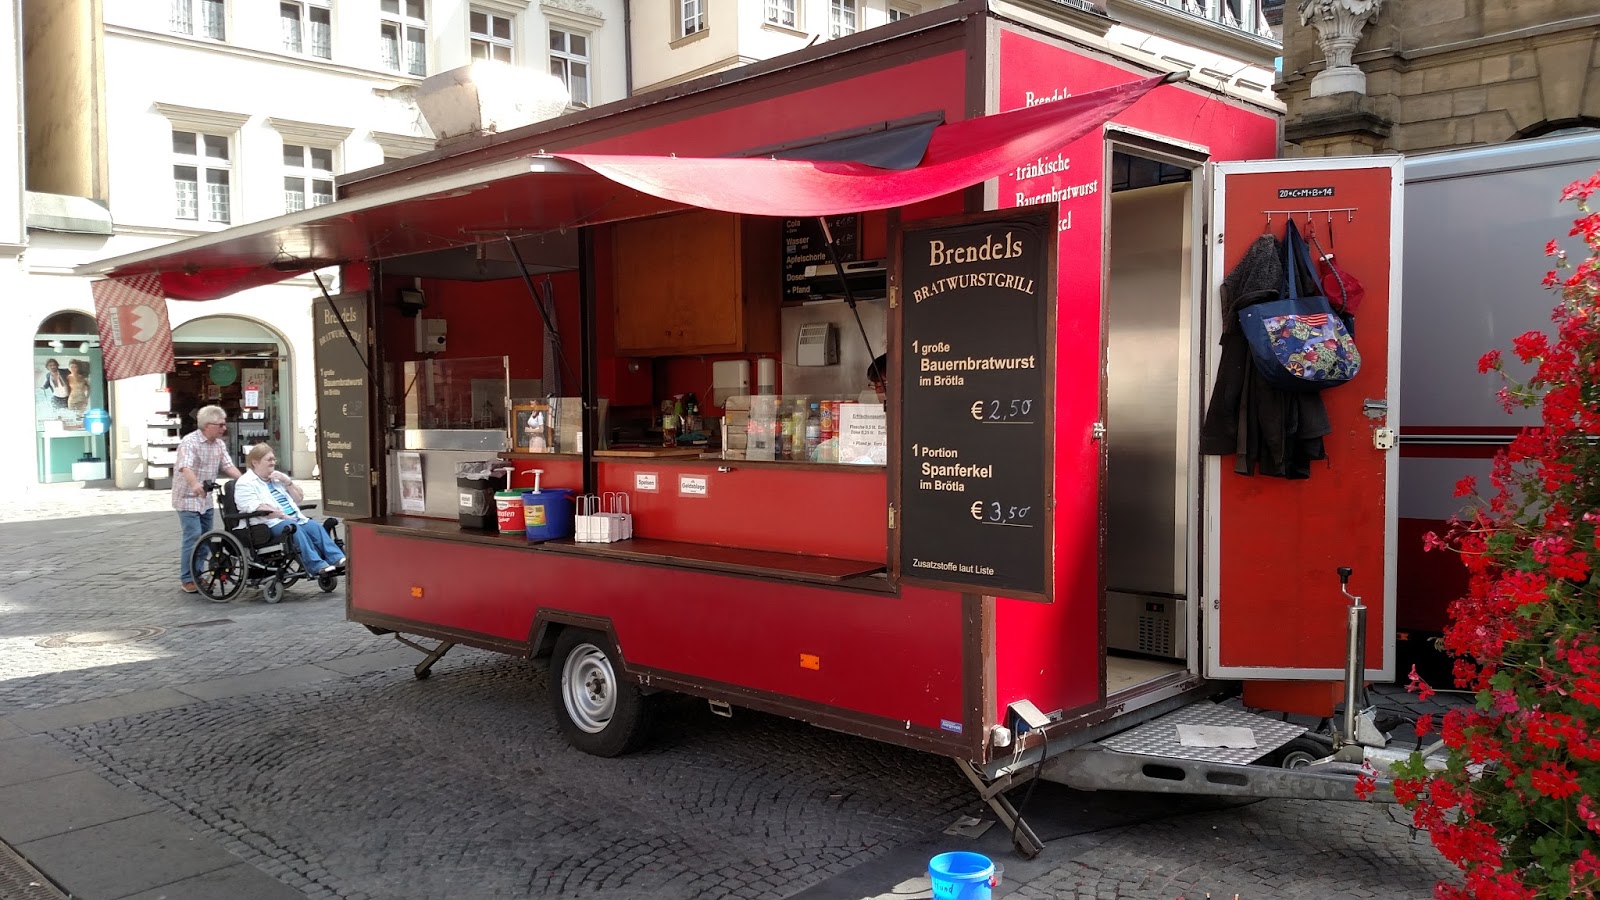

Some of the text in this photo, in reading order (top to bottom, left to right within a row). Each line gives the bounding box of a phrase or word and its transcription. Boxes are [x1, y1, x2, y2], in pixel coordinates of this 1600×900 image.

[786, 220, 800, 228] Cola
[786, 236, 810, 246] Wasser
[929, 232, 1023, 266] Brendels
[786, 252, 826, 264] Apfelschorle
[792, 286, 810, 294] Pfand
[913, 272, 1035, 303] BRATWURSTGRILL
[324, 307, 357, 324] Bredels
[912, 340, 950, 355] 1 große
[920, 354, 1035, 371] Bauernbratwurst
[919, 375, 964, 386] im Brötla
[970, 399, 1032, 421] € 2,50
[912, 443, 958, 458] 1 Portion
[921, 462, 993, 478] Spanferkel
[920, 479, 965, 492] im Brötla
[970, 500, 1031, 524] € 3,50
[913, 558, 994, 576] Zusatzstoffe laut Liste
